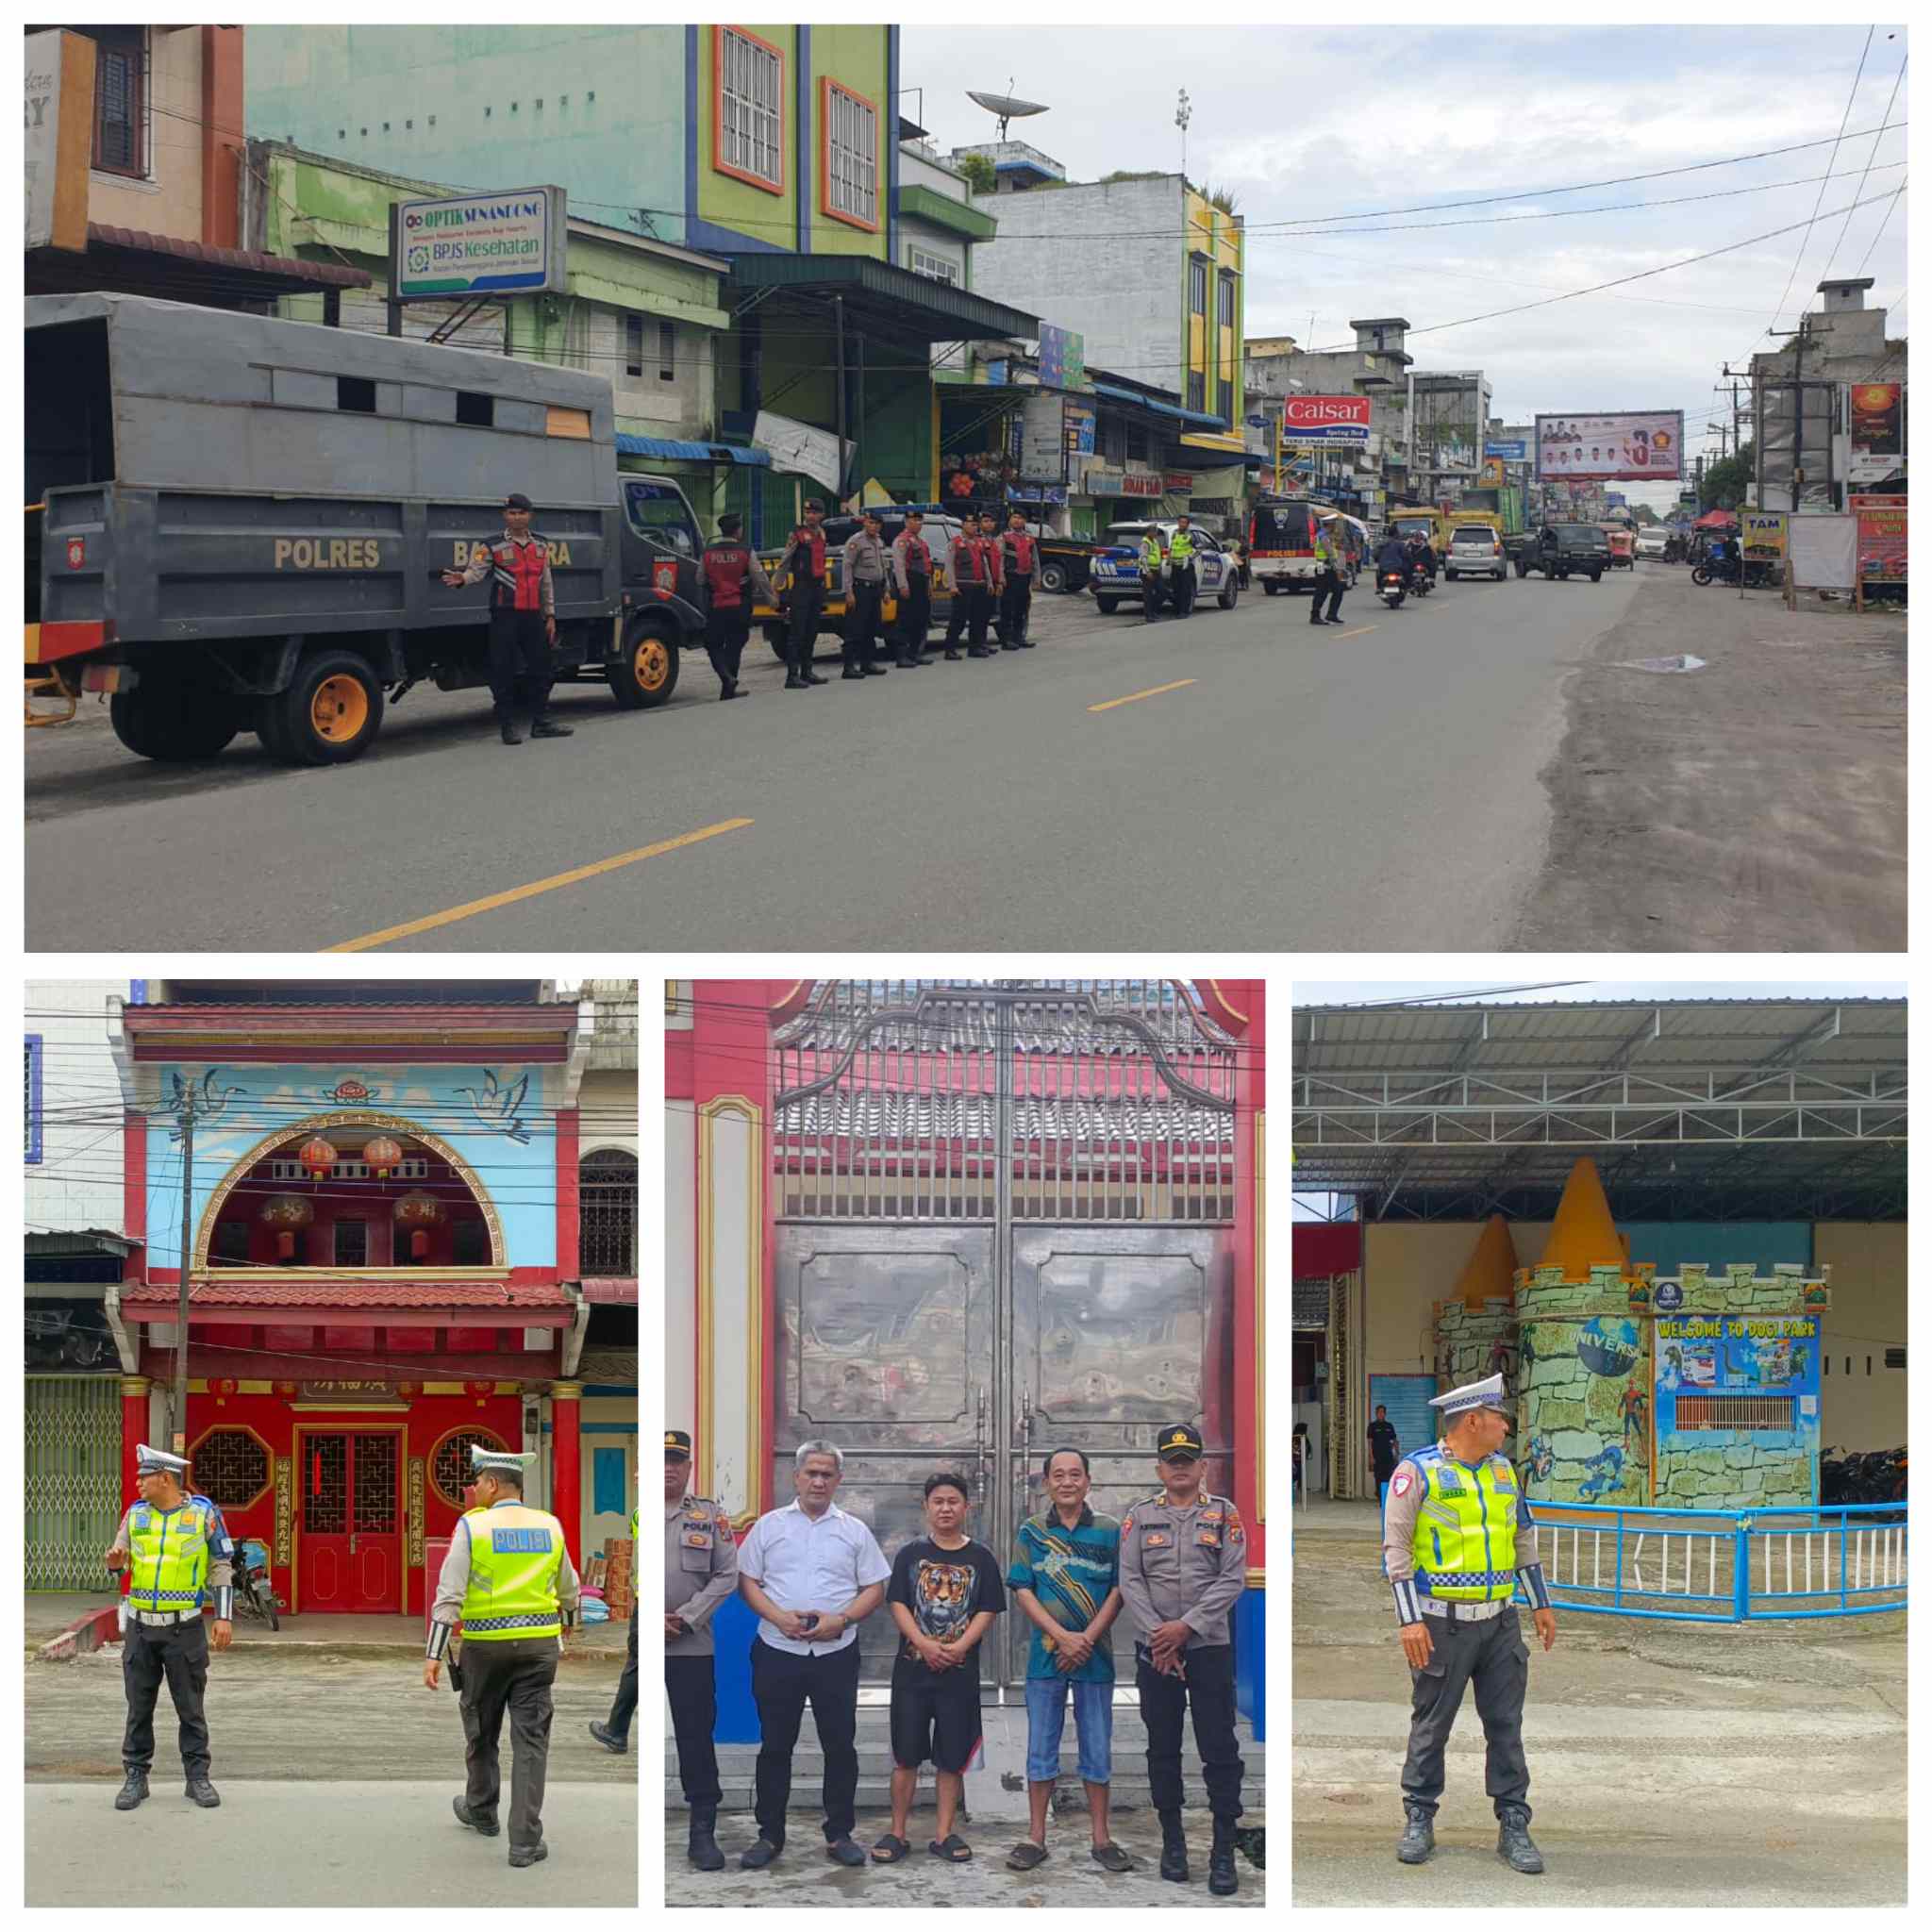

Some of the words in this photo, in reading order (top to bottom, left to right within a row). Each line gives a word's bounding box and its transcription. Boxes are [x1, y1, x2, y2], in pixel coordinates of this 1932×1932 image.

[425, 208, 464, 227] OPTIK
[433, 242, 463, 260] BPJS
[464, 238, 539, 258] Kesehatan
[1287, 400, 1361, 420] Caisar
[1750, 519, 1780, 529] TAM
[275, 539, 380, 568] POLRES
[710, 554, 739, 563] POLISI
[1658, 1322, 1722, 1339] WELCOME
[1728, 1322, 1743, 1338] TO
[1783, 1321, 1815, 1337] PARK
[683, 1523, 711, 1531] POLRI
[495, 1530, 551, 1550] POLISI
